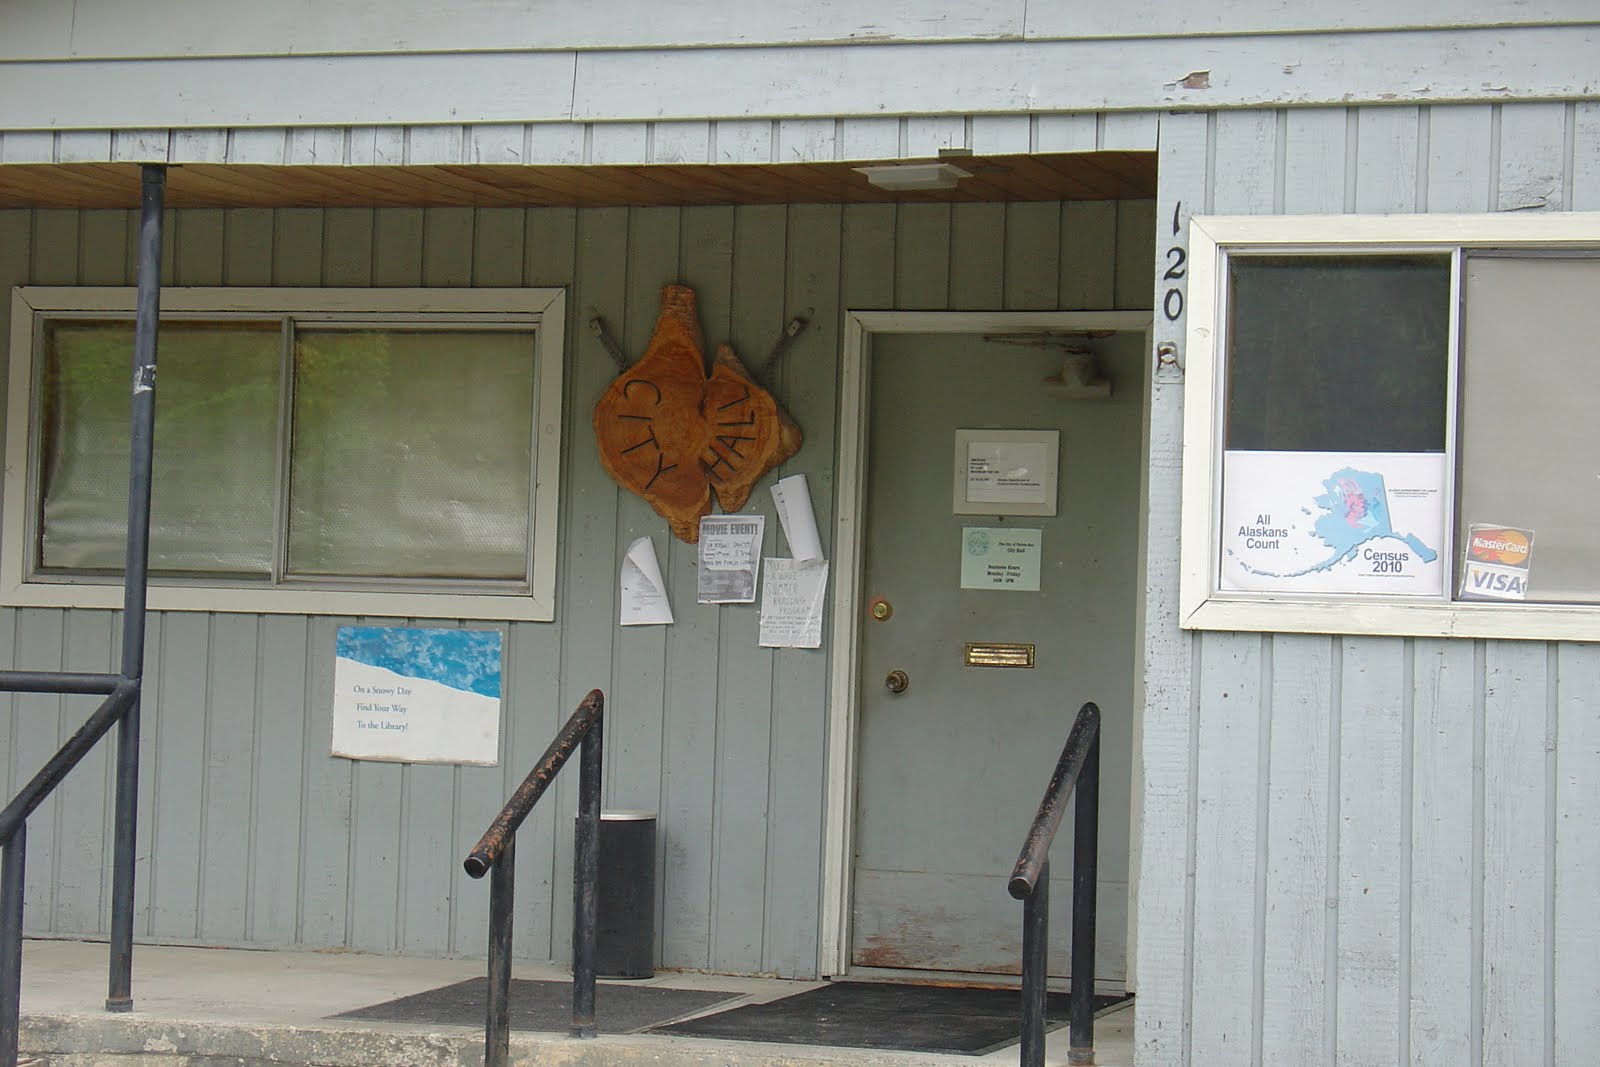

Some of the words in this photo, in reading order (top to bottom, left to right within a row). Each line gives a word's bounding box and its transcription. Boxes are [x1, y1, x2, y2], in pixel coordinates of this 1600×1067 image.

[1163, 201, 1187, 321] 120
[617, 379, 678, 490] CITY
[699, 385, 757, 484] HALL
[1256, 514, 1271, 525] All
[702, 523, 728, 535] MOVIE
[730, 523, 758, 535] EVENT!
[1238, 526, 1288, 538] Alaskans
[1246, 538, 1280, 550] Count
[1473, 537, 1527, 554] MasterCard
[1364, 549, 1409, 562] Census
[1372, 561, 1402, 573] 2010
[1472, 569, 1521, 594] VISA
[766, 582, 798, 596] SUMMER
[353, 685, 366, 694] On
[372, 685, 395, 696] Snowy
[397, 686, 412, 696] Day
[356, 703, 372, 712] Find
[373, 703, 389, 712] Your
[391, 704, 407, 714] Way
[357, 720, 366, 729] To
[367, 720, 378, 729] the
[380, 720, 409, 733] Library!
